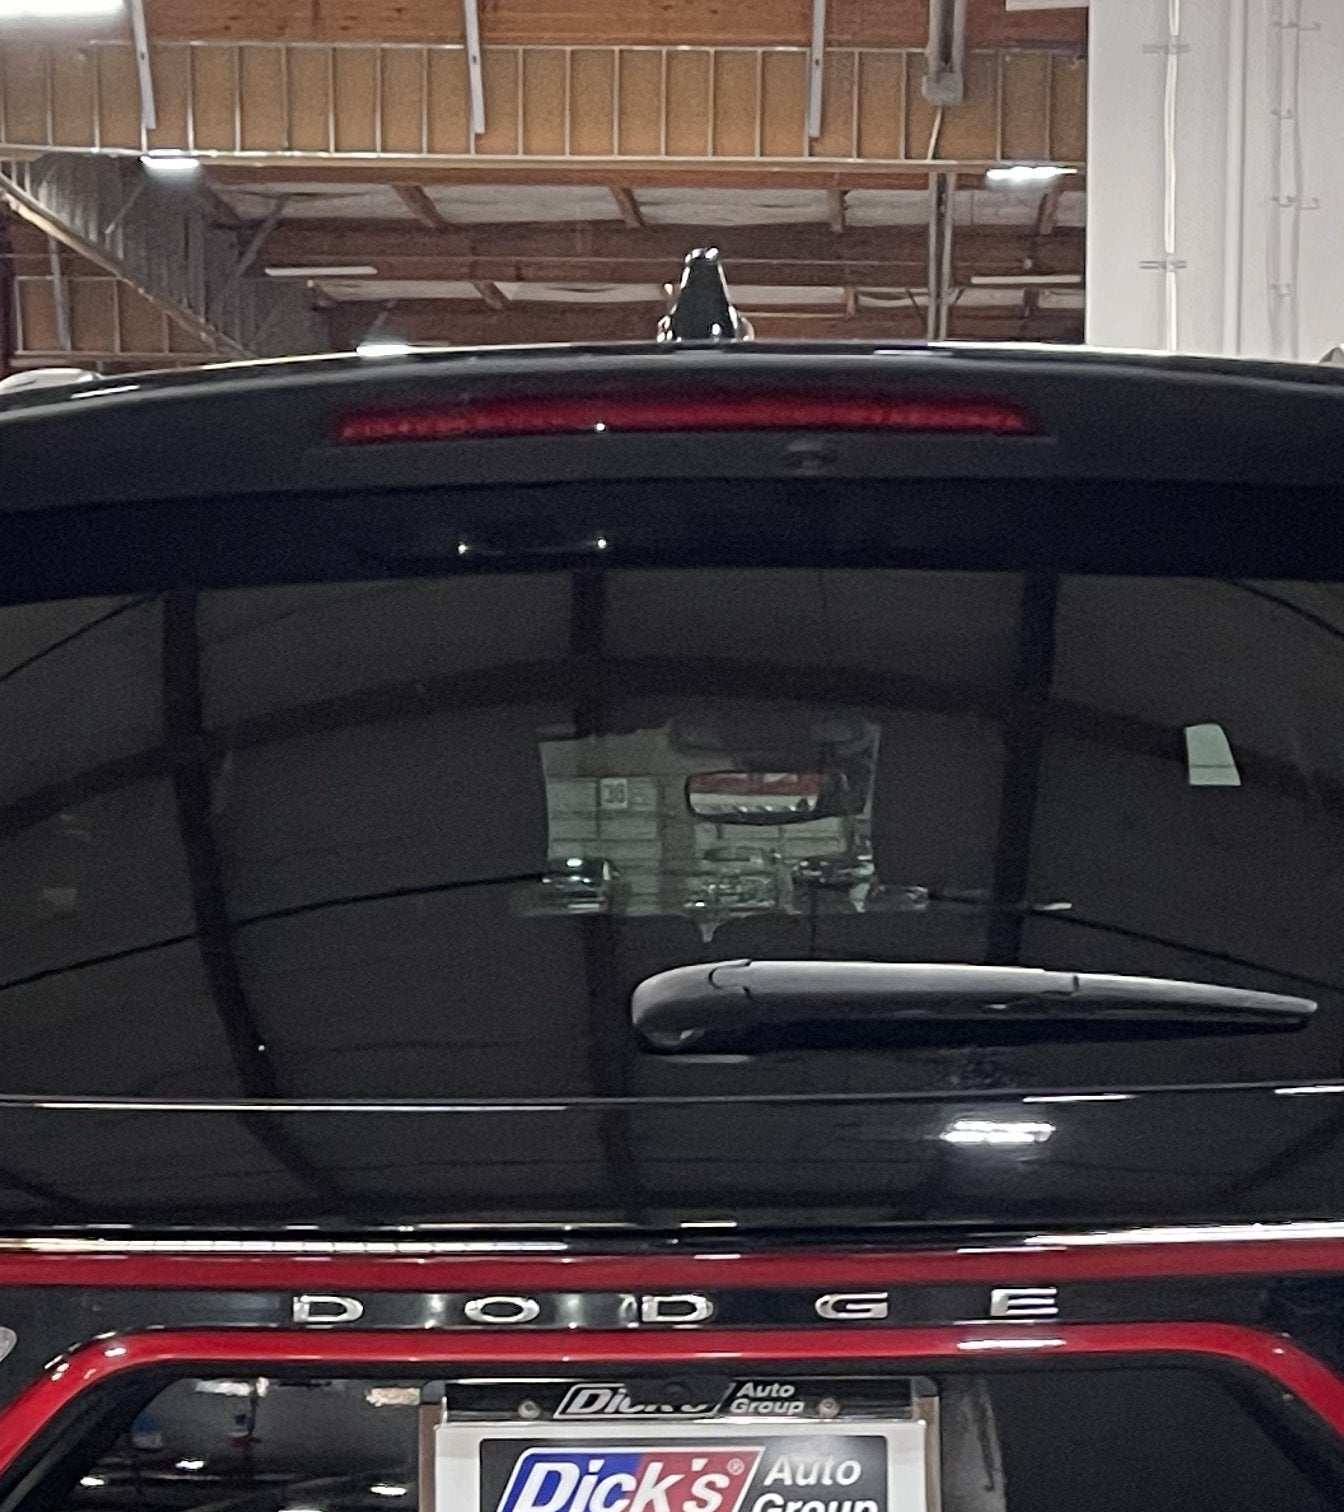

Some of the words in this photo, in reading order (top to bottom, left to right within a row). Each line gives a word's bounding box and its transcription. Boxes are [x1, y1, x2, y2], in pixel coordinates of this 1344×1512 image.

[292, 1287, 1059, 1325] DODGE
[737, 1382, 795, 1397] Auto
[730, 1398, 805, 1416] Group
[763, 1456, 862, 1486] Auto
